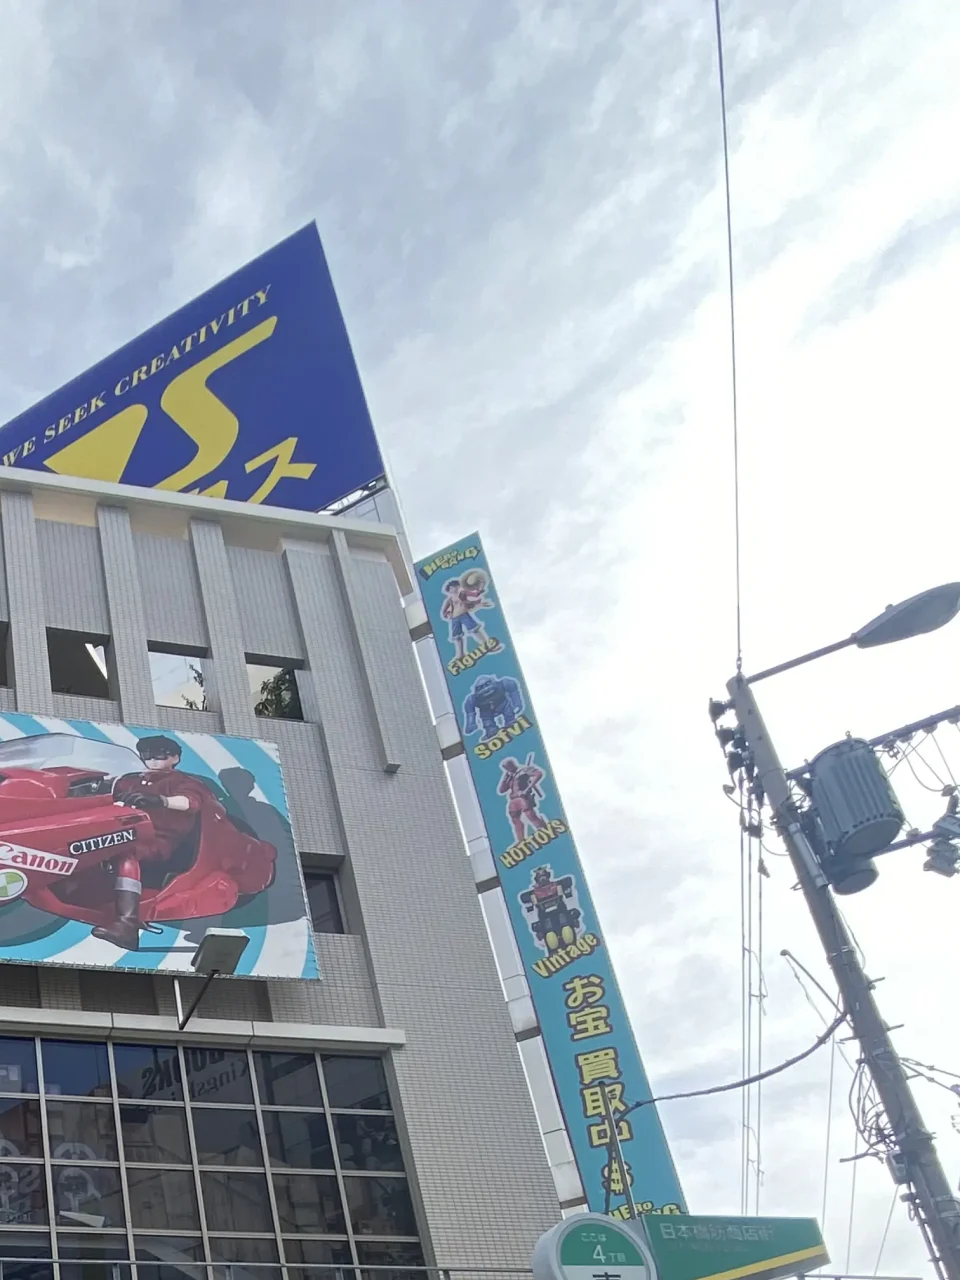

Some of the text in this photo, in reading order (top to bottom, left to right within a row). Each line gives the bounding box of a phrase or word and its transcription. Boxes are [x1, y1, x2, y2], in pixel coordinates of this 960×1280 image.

[0, 284, 272, 467] WE SEEK CREATIVITY
[445, 638, 499, 676] Figure
[473, 715, 533, 760] Sofvi
[68, 829, 136, 856] CITIZEN
[532, 931, 600, 979] Vintage
[580, 1232, 608, 1243] ここは
